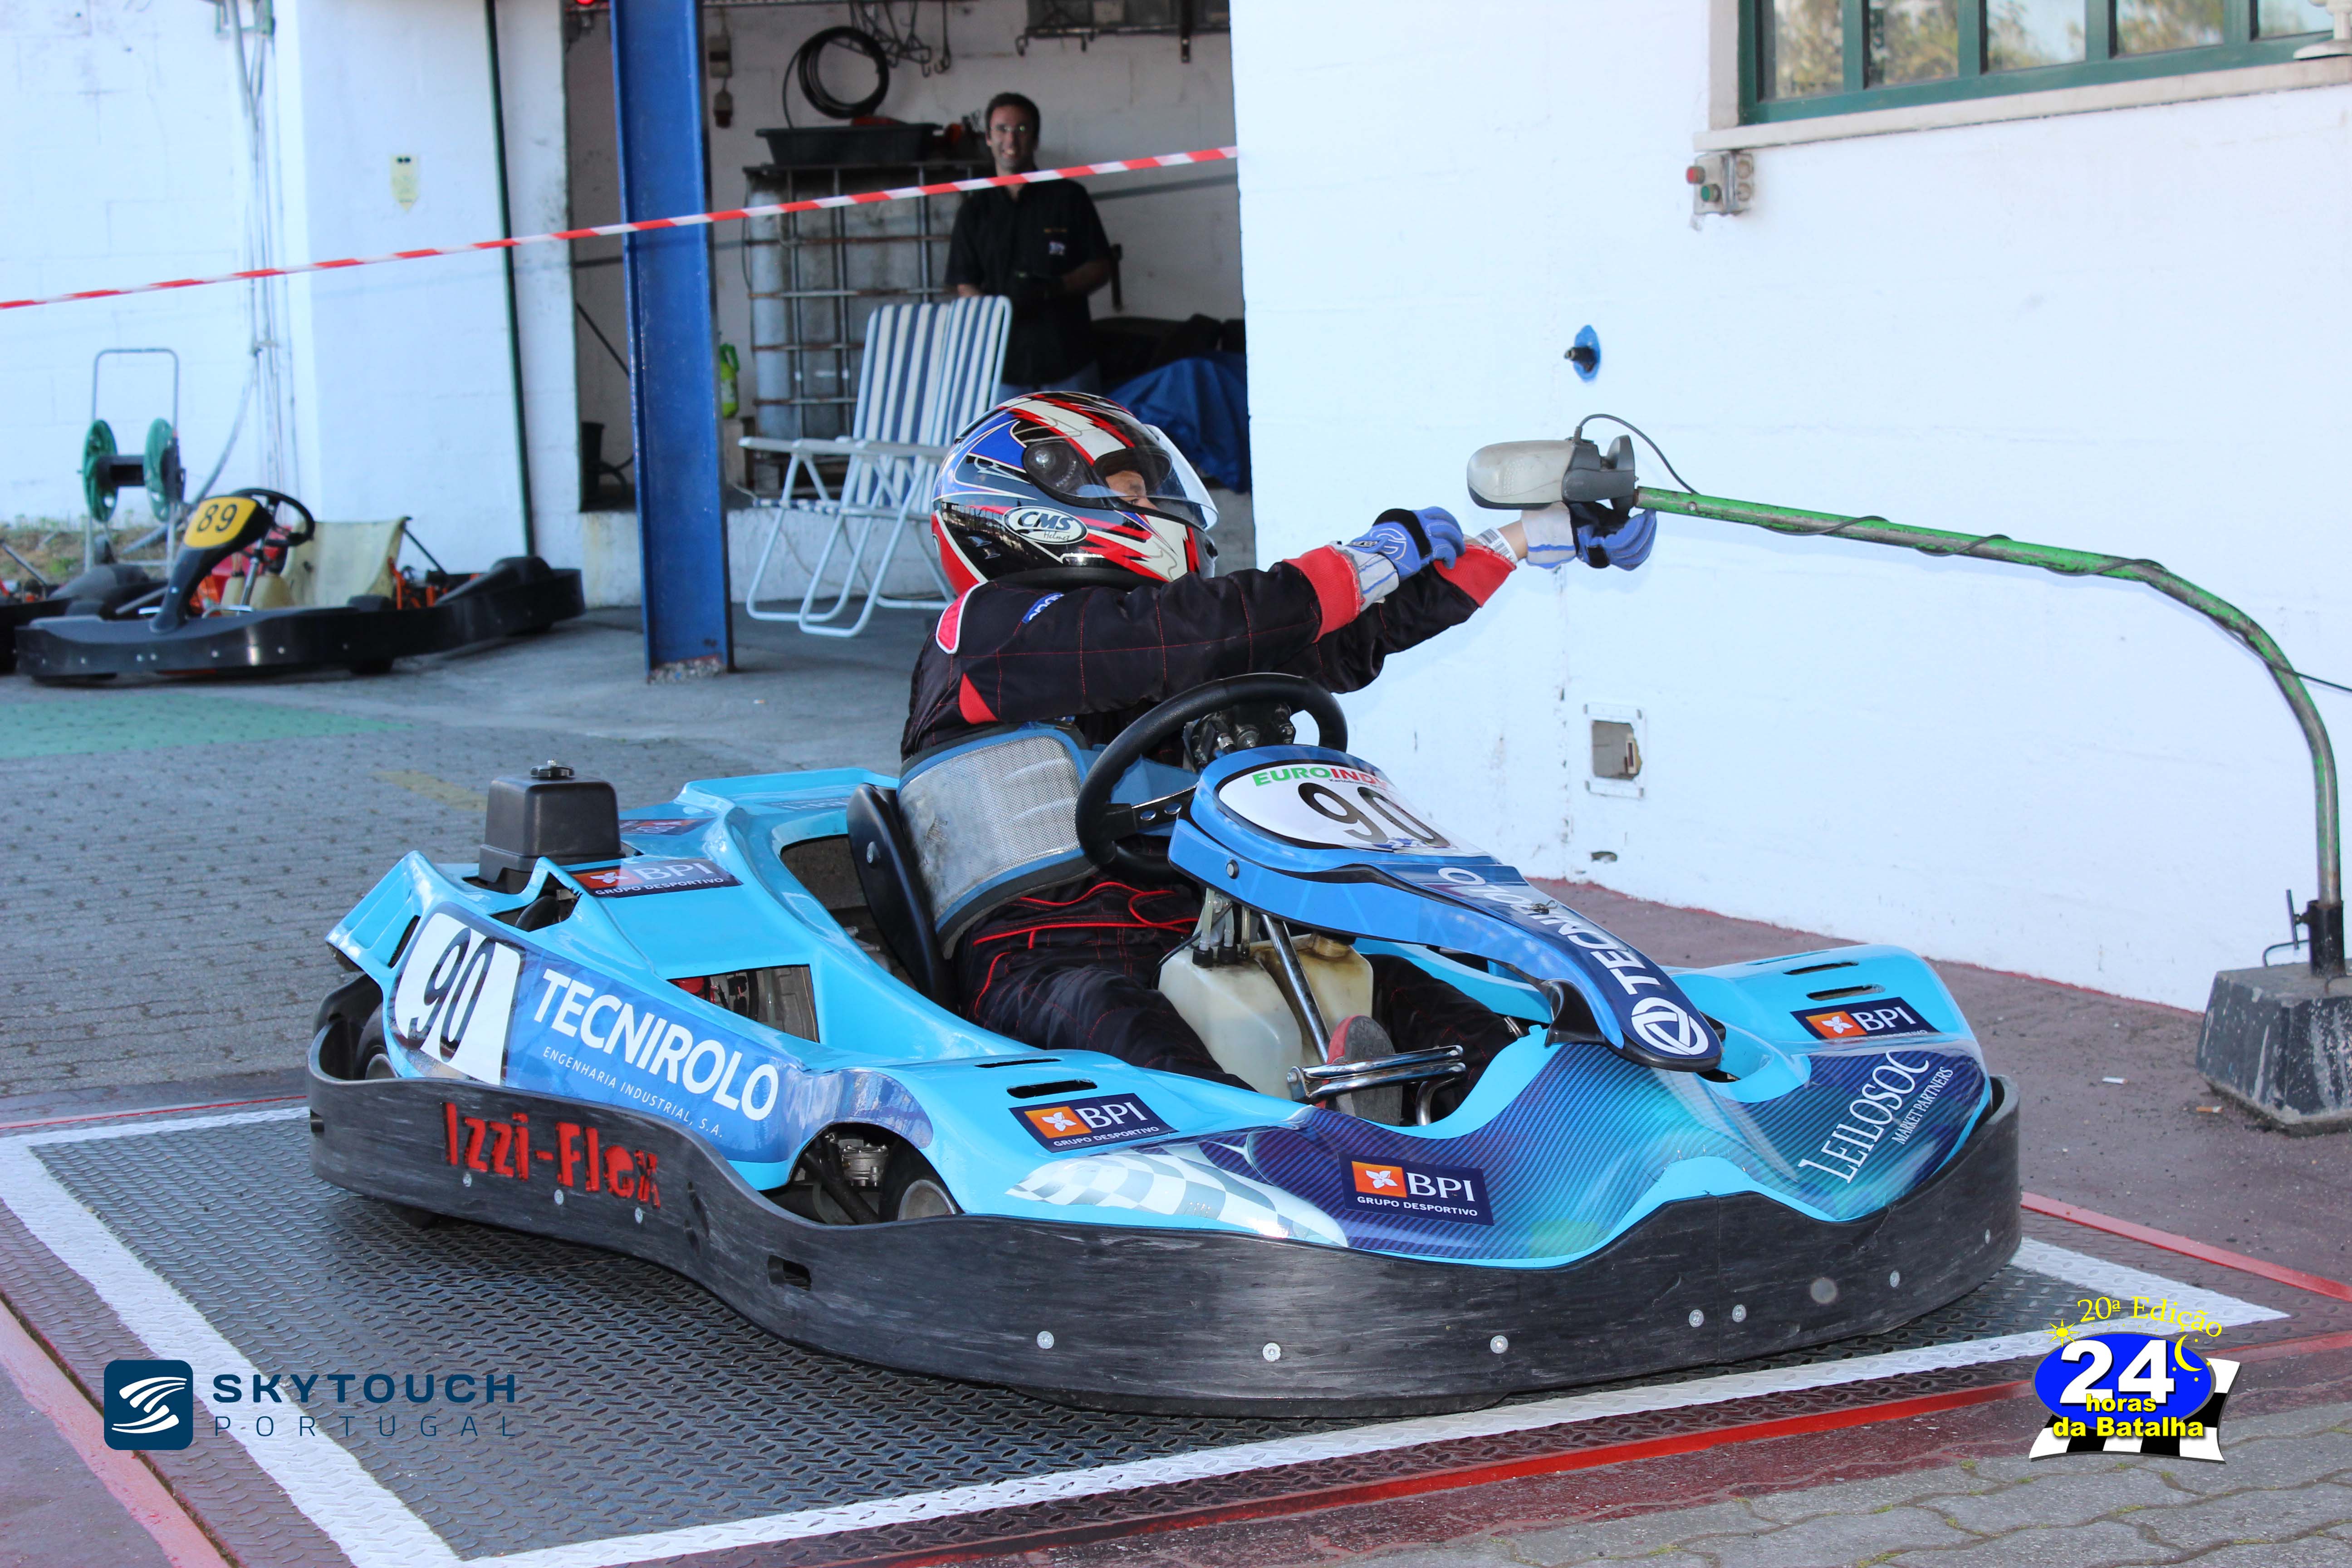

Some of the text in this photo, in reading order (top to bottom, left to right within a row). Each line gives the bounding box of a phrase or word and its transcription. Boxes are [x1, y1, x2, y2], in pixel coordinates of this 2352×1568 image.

[196, 504, 237, 532] 89
[1018, 511, 1074, 530] CMS
[1043, 531, 1070, 540] Helmet
[1298, 783, 1450, 847] 90
[632, 862, 714, 881] BPI
[595, 877, 724, 896] GRUPO DESPORTIVO
[408, 927, 496, 1063] 90
[1851, 1006, 1916, 1031] BPI
[534, 968, 779, 1121] TECNIROLO
[543, 1046, 723, 1137] ENGENHARIA INDUSTRIAL, S.A.
[1075, 1102, 1148, 1129] BPI
[1798, 1049, 1929, 1184] LEILOSOC
[1891, 1066, 1953, 1145] MARKET PARTNERS
[1054, 1126, 1159, 1147] GRUPO DESPORTIVO
[1406, 1172, 1475, 1202] BPI
[1357, 1196, 1478, 1216] GRUPO DESPORTIVO
